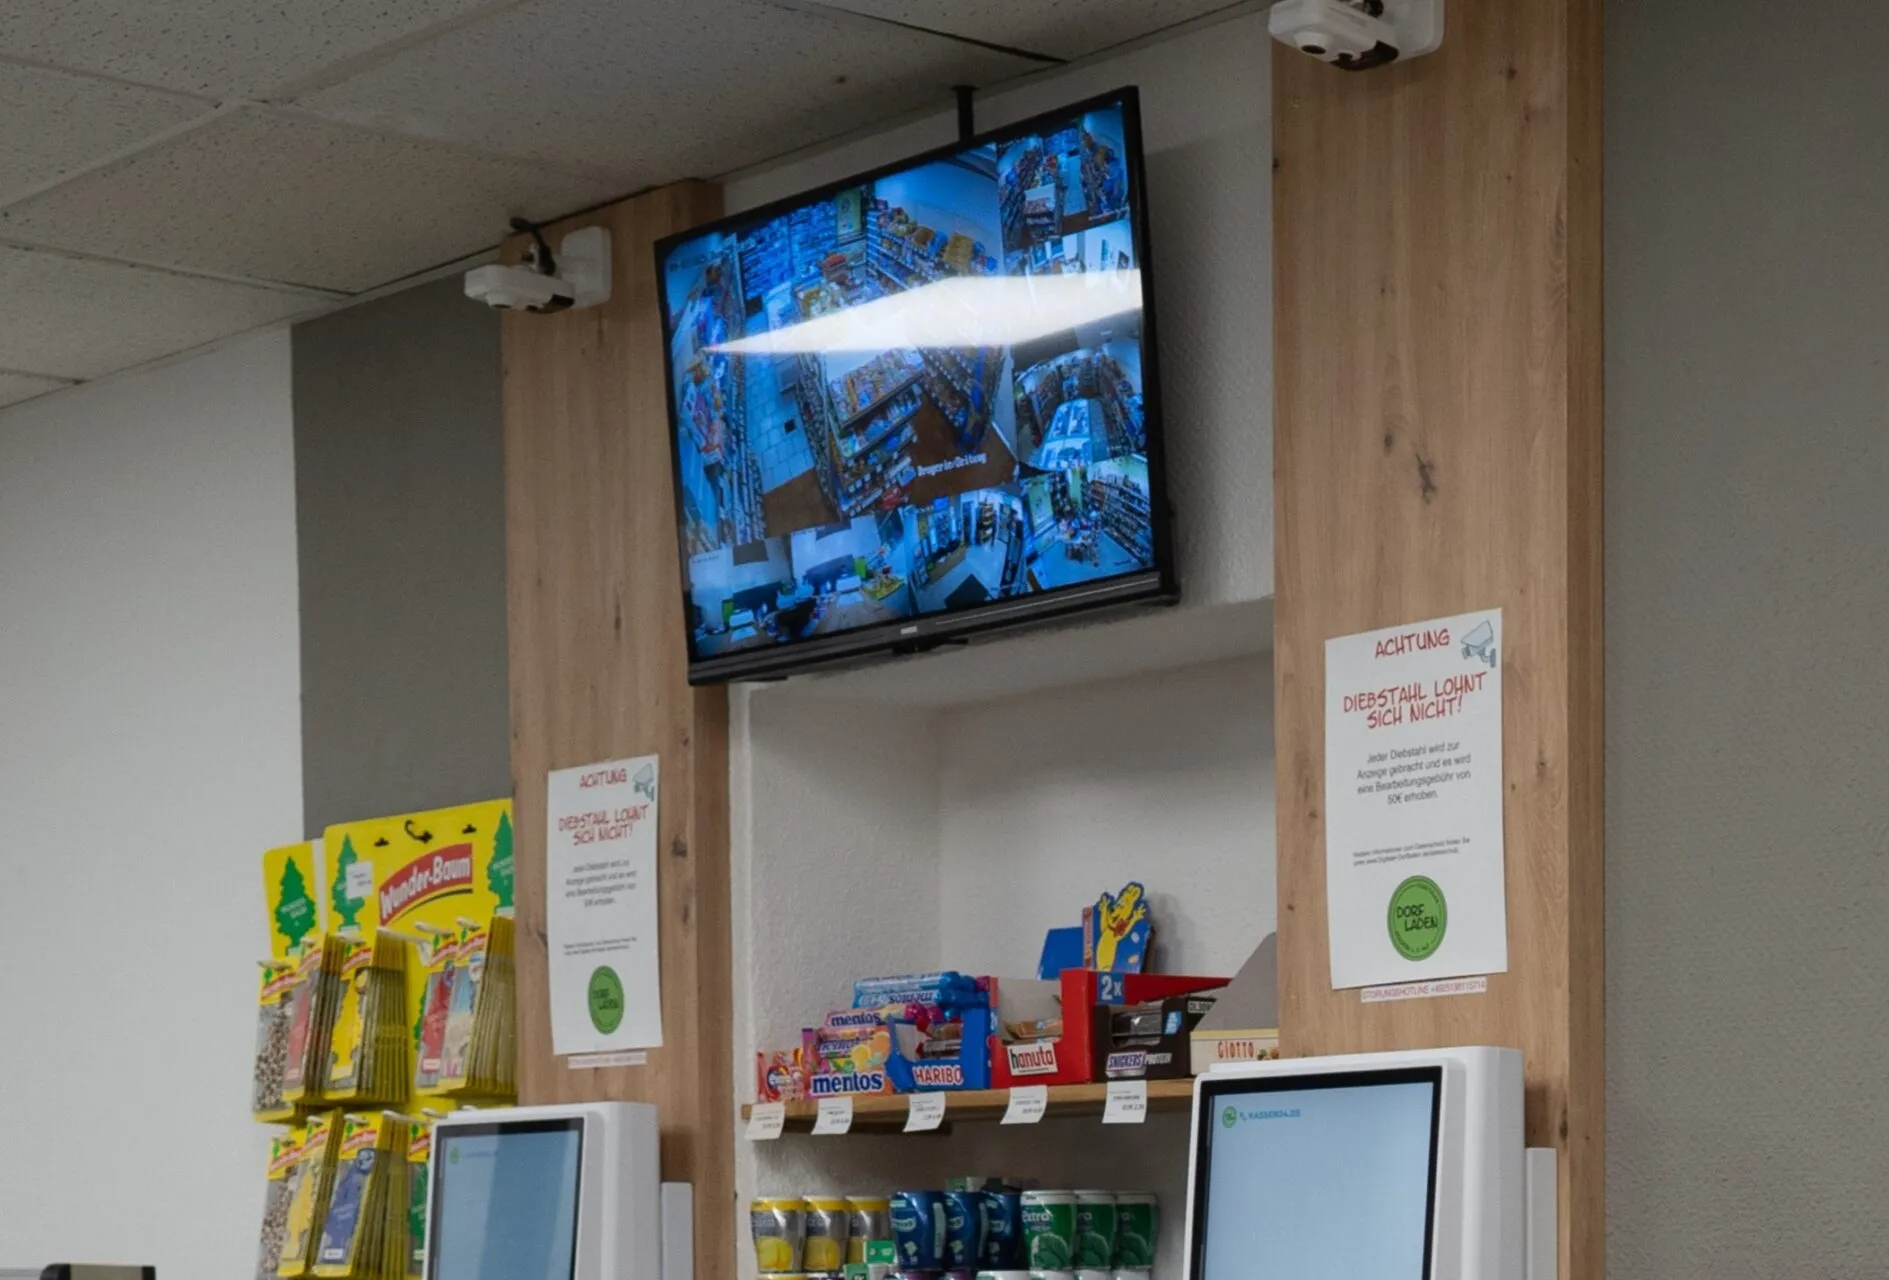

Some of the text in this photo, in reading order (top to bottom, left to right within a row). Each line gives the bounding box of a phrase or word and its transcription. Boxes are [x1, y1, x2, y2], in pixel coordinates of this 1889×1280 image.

[1374, 628, 1450, 659] ACHTUNG
[1343, 671, 1488, 713] DIEBSTAHL LOHNT
[1366, 695, 1463, 729] SICH NICHT!
[1367, 741, 1460, 764] Jeder Diebstahl wird zur
[579, 768, 628, 789] ACHTUNG
[1357, 754, 1472, 781] Anzeige gebracht und es wird
[1357, 769, 1471, 794] eine Bearbeitungsgebühr von
[1404, 790, 1439, 805] erhoben.
[558, 804, 649, 832] DIEBSTAHL LOHNT
[572, 823, 633, 846] SICH NICHT!
[380, 855, 470, 918] Wunder-Baum
[1396, 903, 1425, 919] DORF
[1404, 916, 1439, 932] LADEN
[831, 1012, 882, 1026] mentos
[1010, 1043, 1054, 1067] hanuta
[1107, 1053, 1144, 1069] SNICKERS
[812, 1073, 884, 1094] mentos
[915, 1065, 962, 1085] HARIBO
